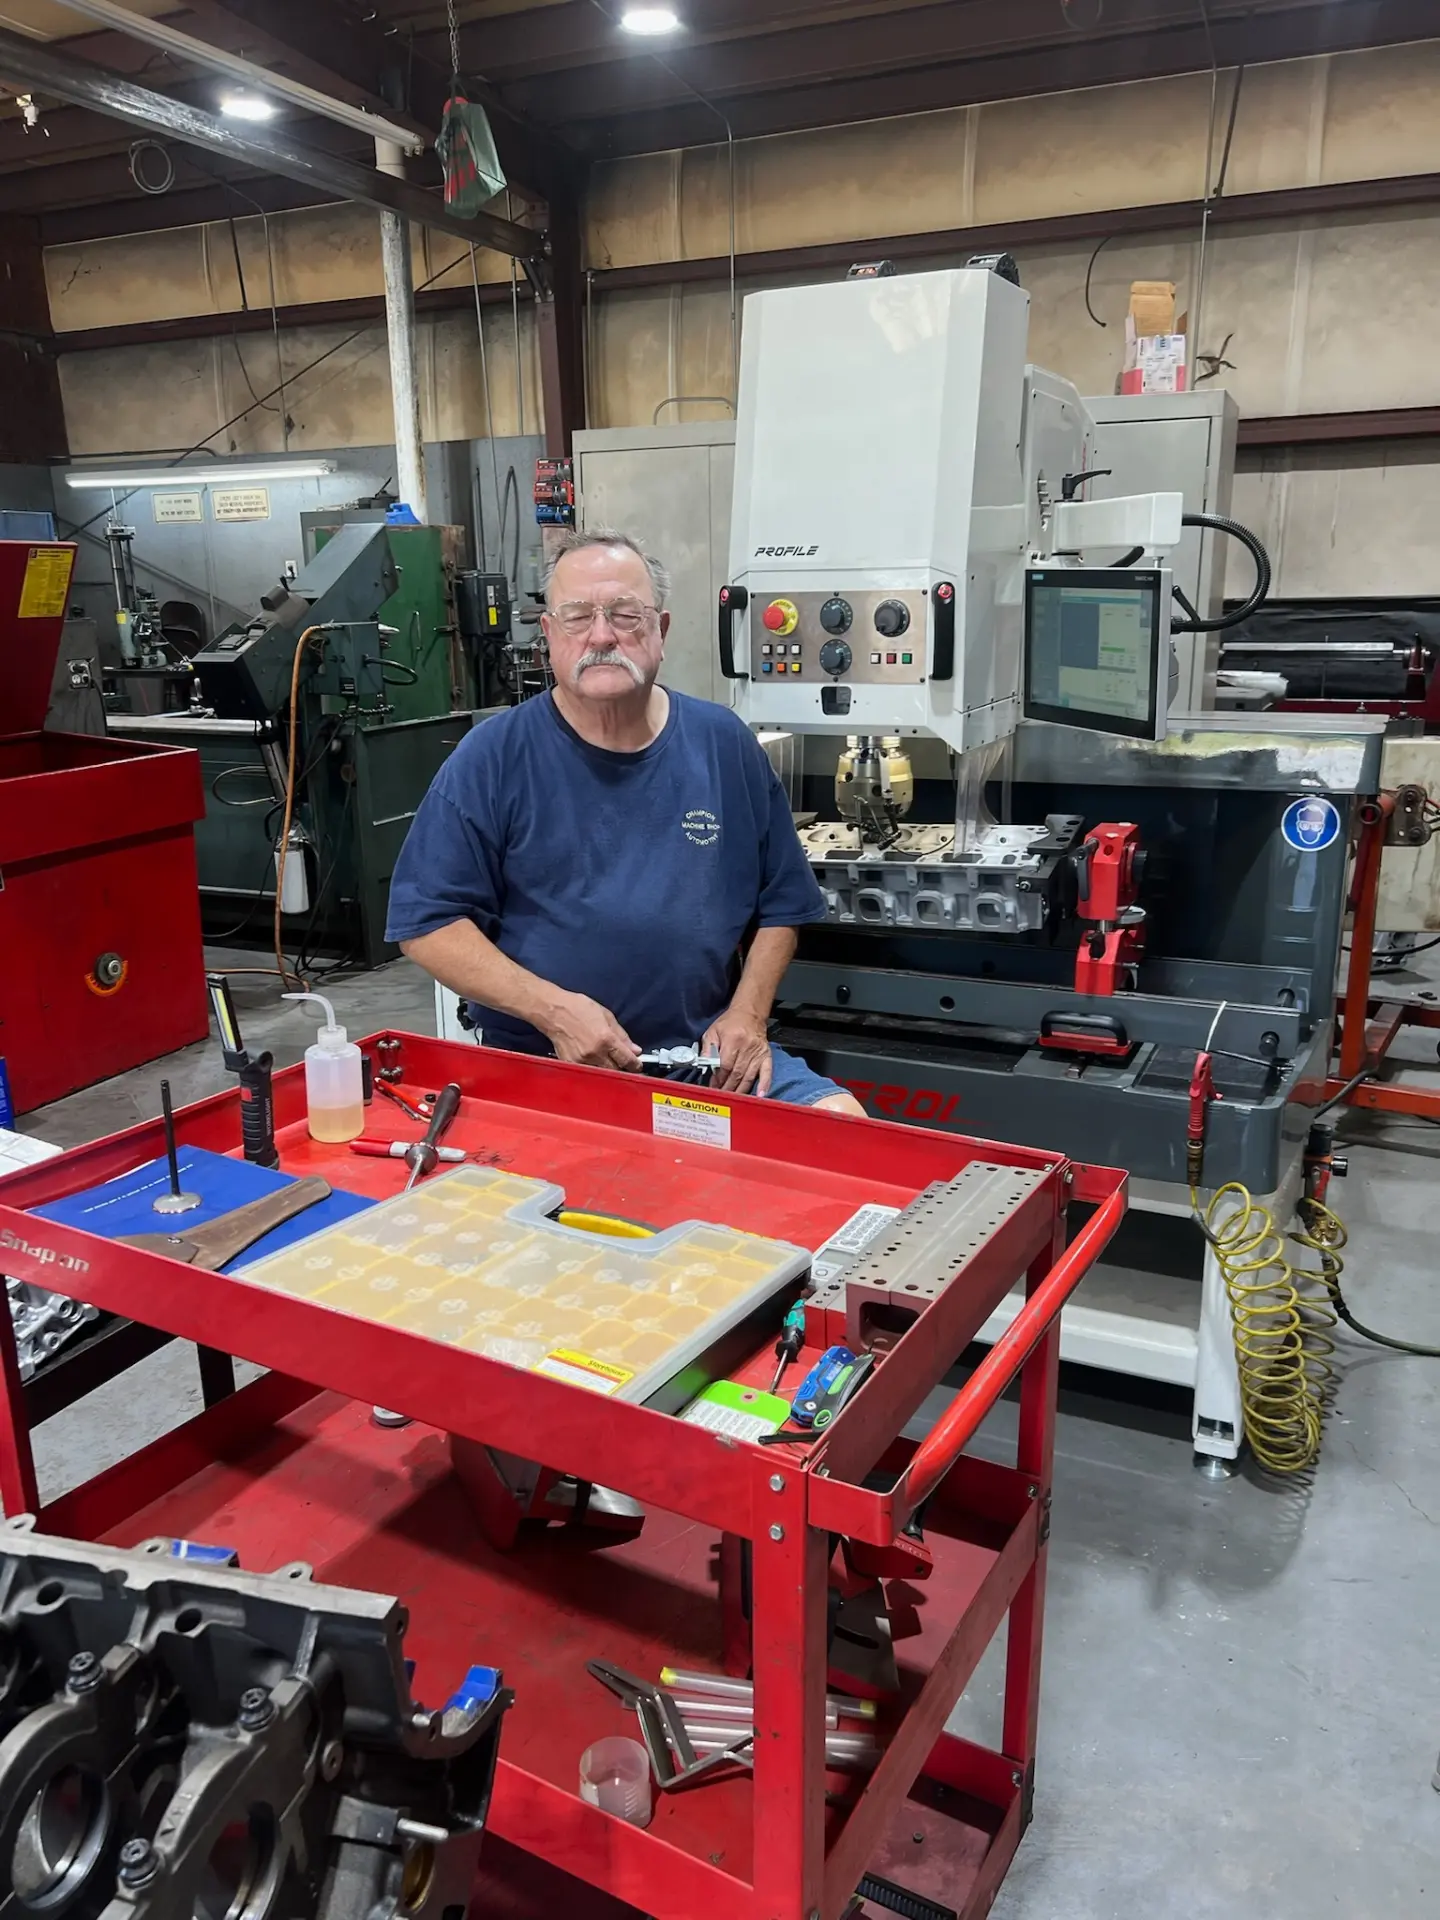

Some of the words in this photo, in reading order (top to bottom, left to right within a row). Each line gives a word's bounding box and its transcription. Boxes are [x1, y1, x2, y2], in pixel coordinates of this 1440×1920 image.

[754, 545, 819, 557] PROFILE
[685, 809, 716, 822] CHAMPION
[681, 821, 706, 830] MACHINE
[829, 1075, 961, 1122] ERDI
[680, 1100, 719, 1113] CAUTION
[588, 1360, 626, 1377] Storehouse
